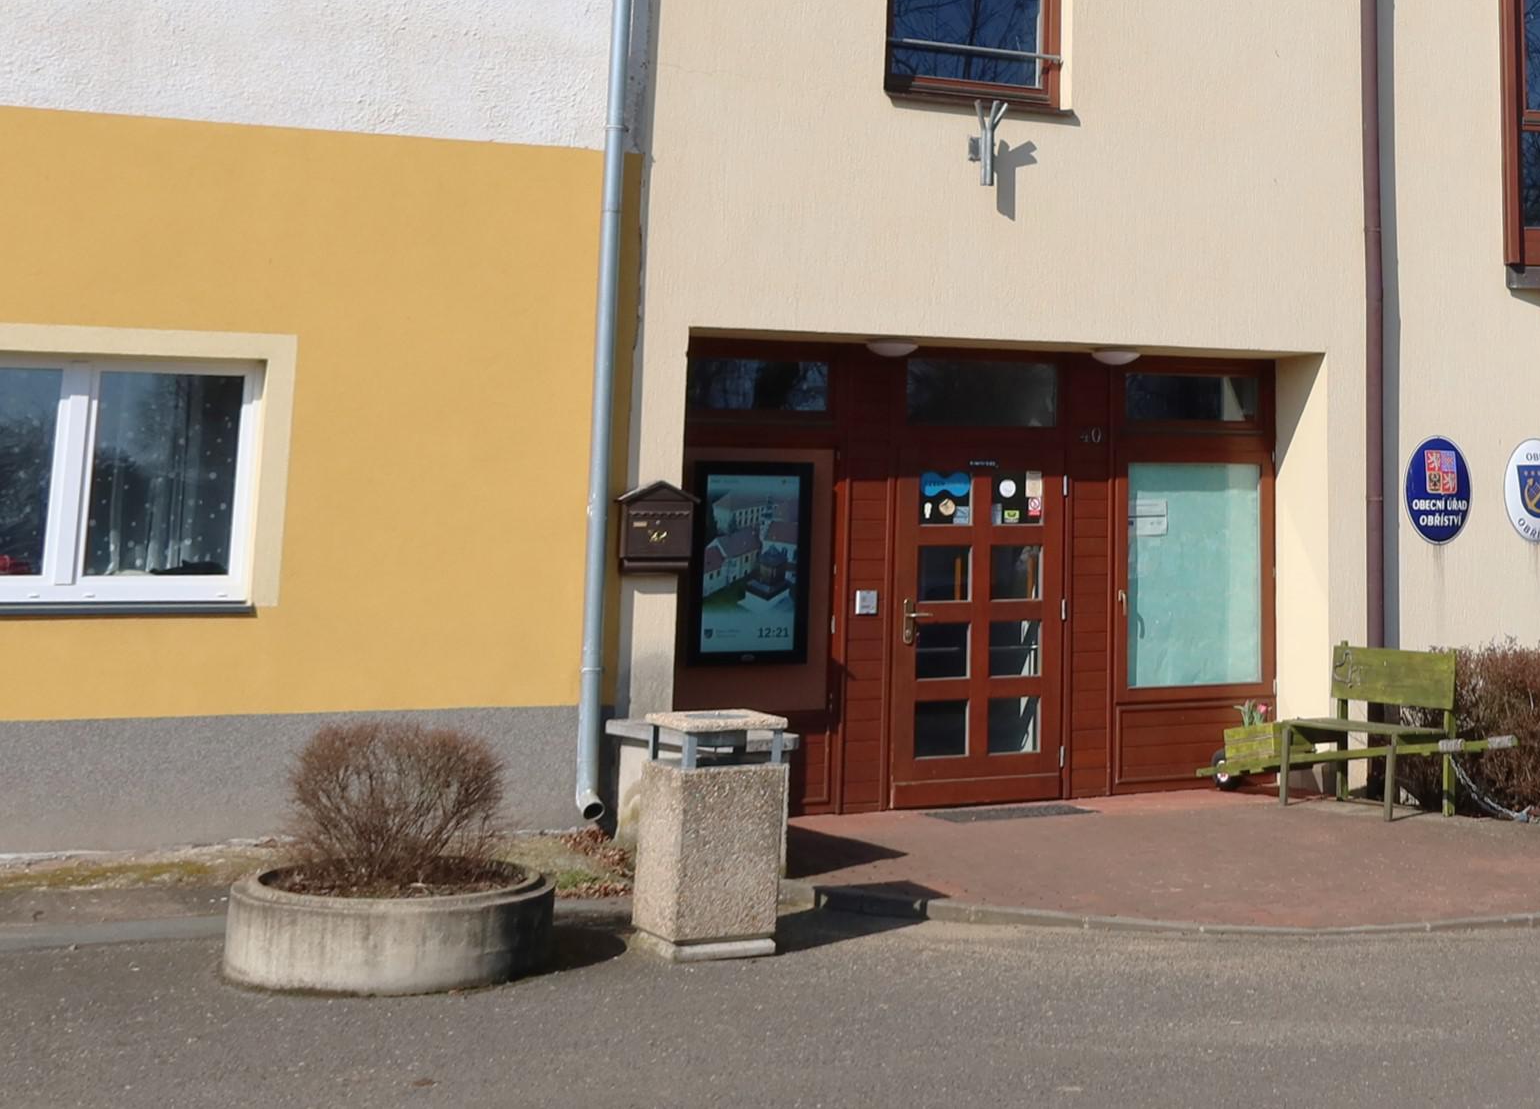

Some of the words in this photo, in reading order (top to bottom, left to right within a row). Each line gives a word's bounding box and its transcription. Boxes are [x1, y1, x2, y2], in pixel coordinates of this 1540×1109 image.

[1412, 497, 1445, 511] OBECNÍ
[1446, 497, 1468, 511] ÚŘAD
[1419, 512, 1463, 527] OBŘÍSTVÍ
[757, 626, 790, 639] 12:21
